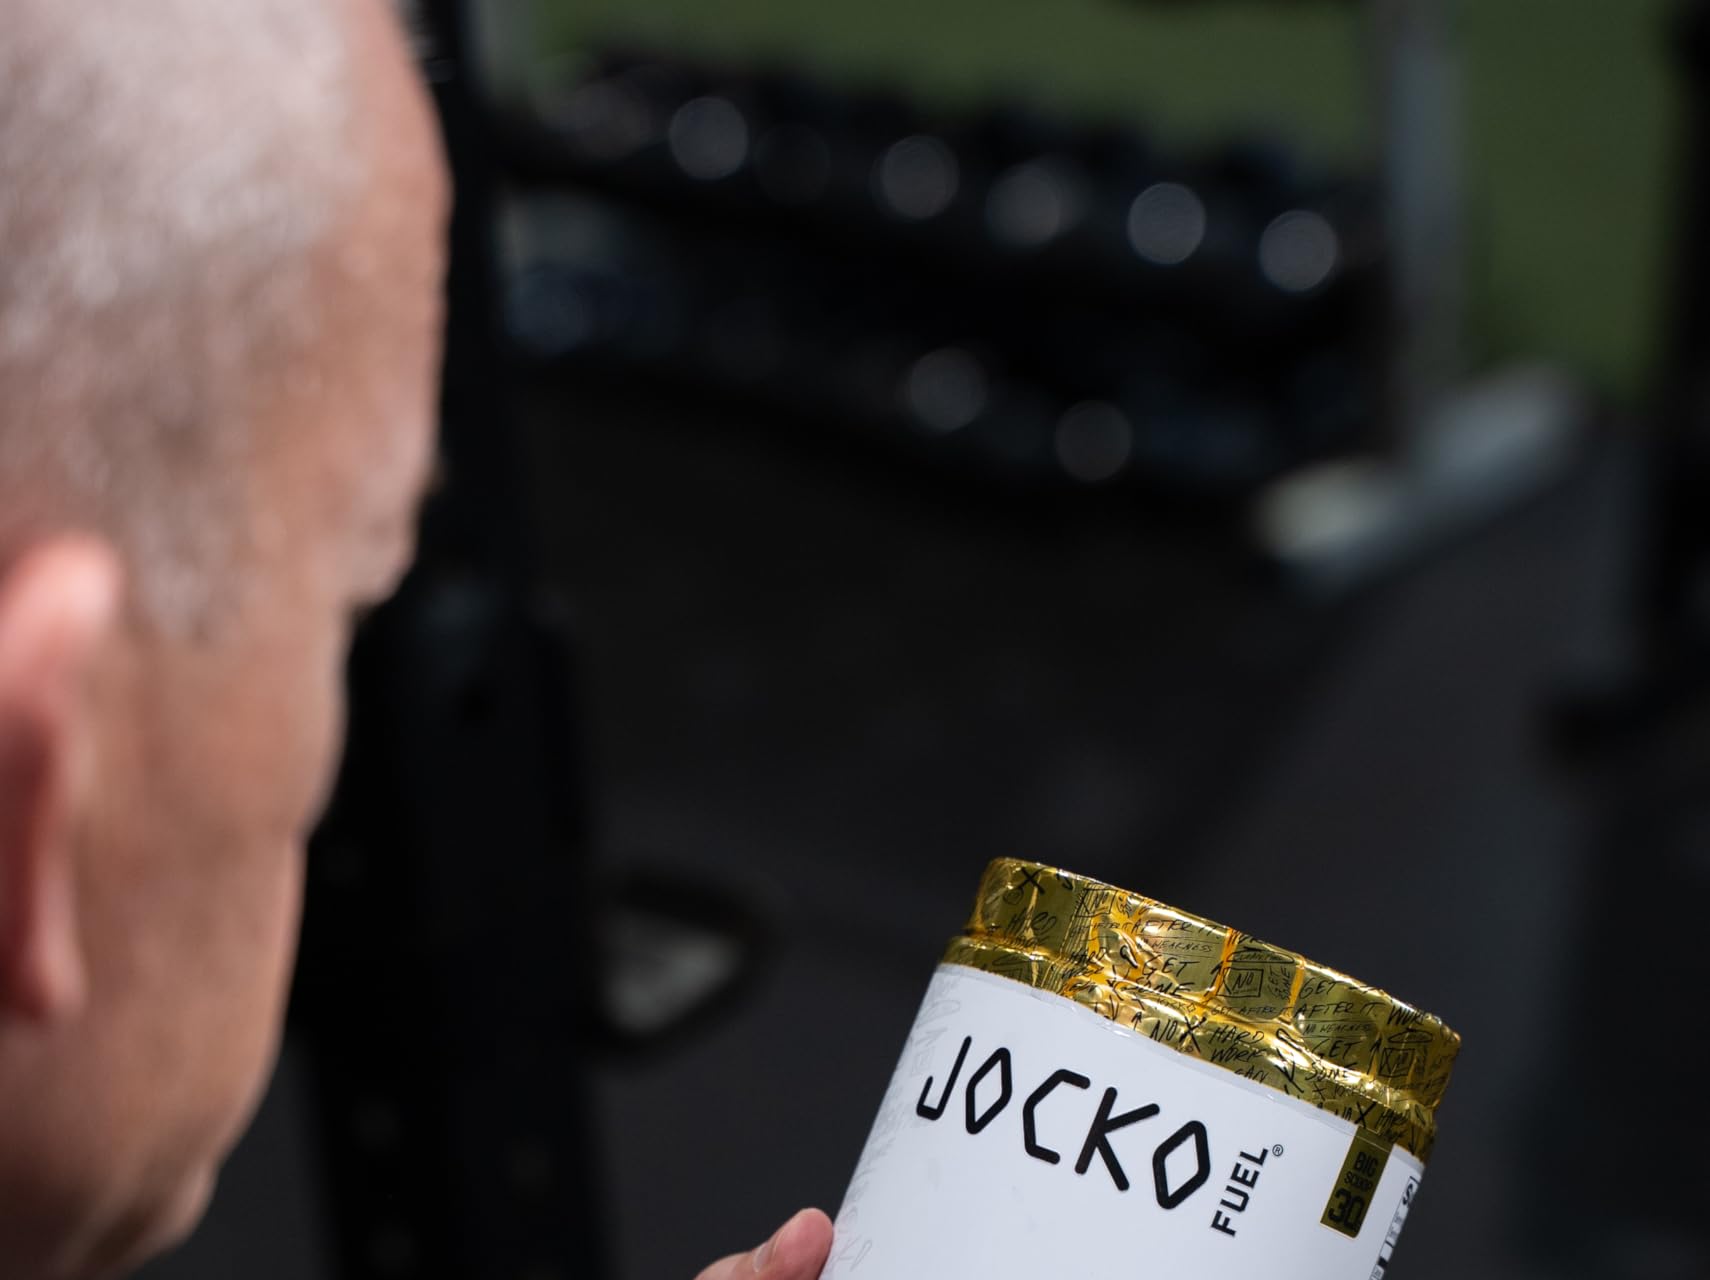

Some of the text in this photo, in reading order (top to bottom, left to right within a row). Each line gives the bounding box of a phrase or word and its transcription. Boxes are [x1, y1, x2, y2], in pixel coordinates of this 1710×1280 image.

[1232, 972, 1254, 991] NO
[1299, 977, 1339, 1000] GET
[1298, 1001, 1356, 1019] AFTER
[1208, 1024, 1265, 1045] HARD
[916, 1036, 1211, 1210] JOCKO
[1354, 1151, 1379, 1177] BIG
